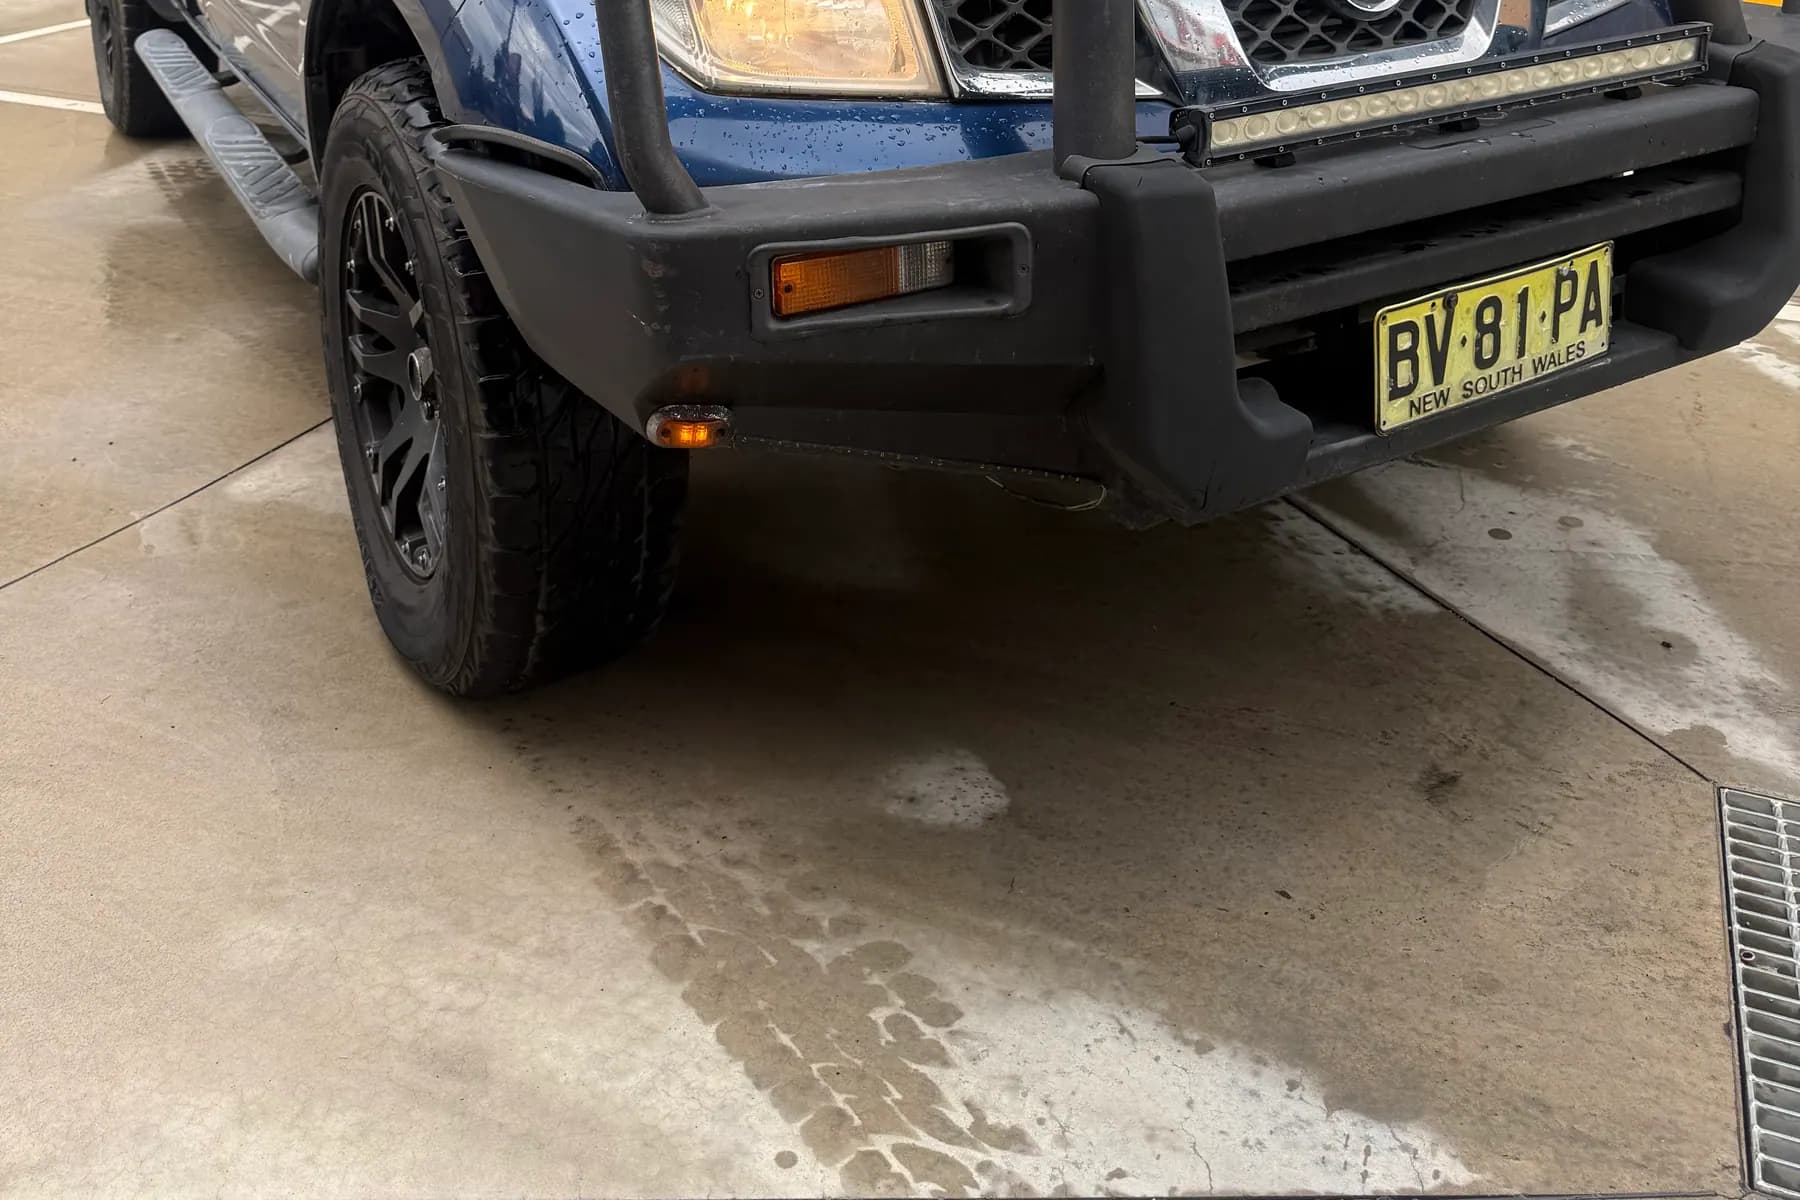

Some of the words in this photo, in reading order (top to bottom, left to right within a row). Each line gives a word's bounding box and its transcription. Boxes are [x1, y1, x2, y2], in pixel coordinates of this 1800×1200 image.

[1409, 387, 1451, 418] NEW
[1461, 364, 1523, 399] SOUTH
[1532, 340, 1586, 374] WALES
